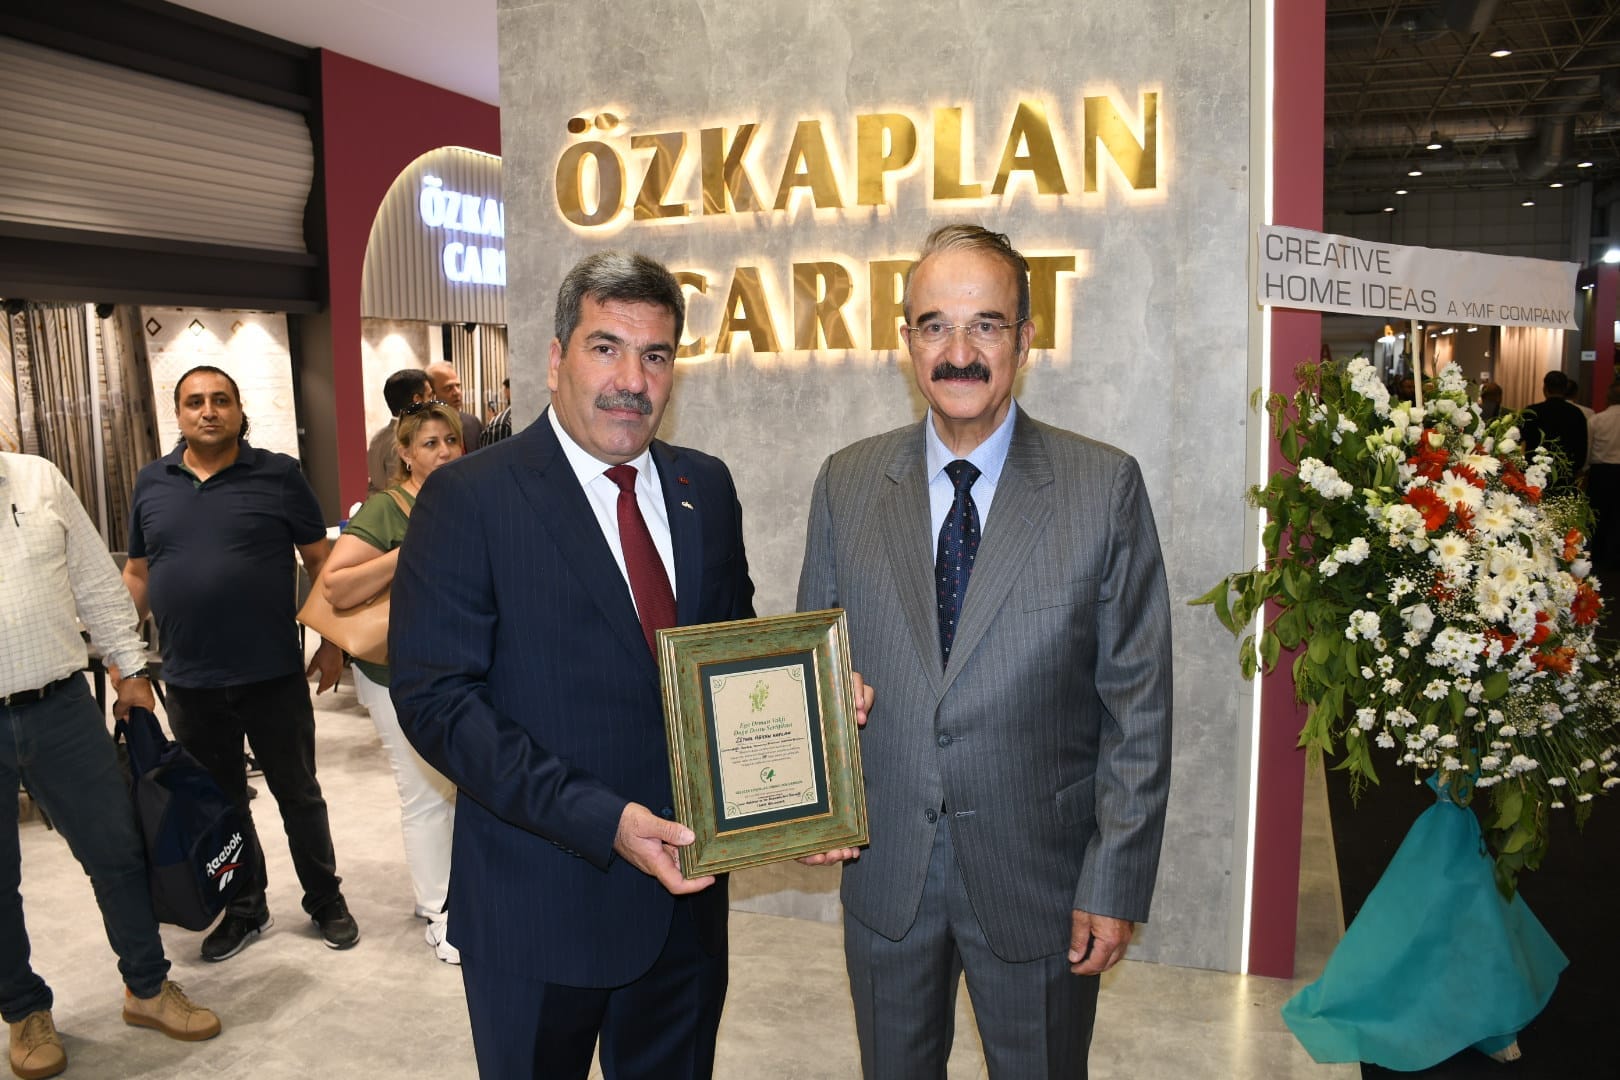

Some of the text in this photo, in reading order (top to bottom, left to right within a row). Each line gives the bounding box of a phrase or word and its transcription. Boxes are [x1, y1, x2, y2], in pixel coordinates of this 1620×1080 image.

[555, 92, 1158, 226] ÖZKAPLAN
[420, 175, 504, 239] ÖZKA
[1266, 234, 1391, 274] CREATIVE
[674, 256, 1076, 358] CARPT
[1266, 272, 1437, 314] HOME IDEAS
[1447, 301, 1571, 324] A YMF COMPANY
[206, 832, 242, 877] Reebok
